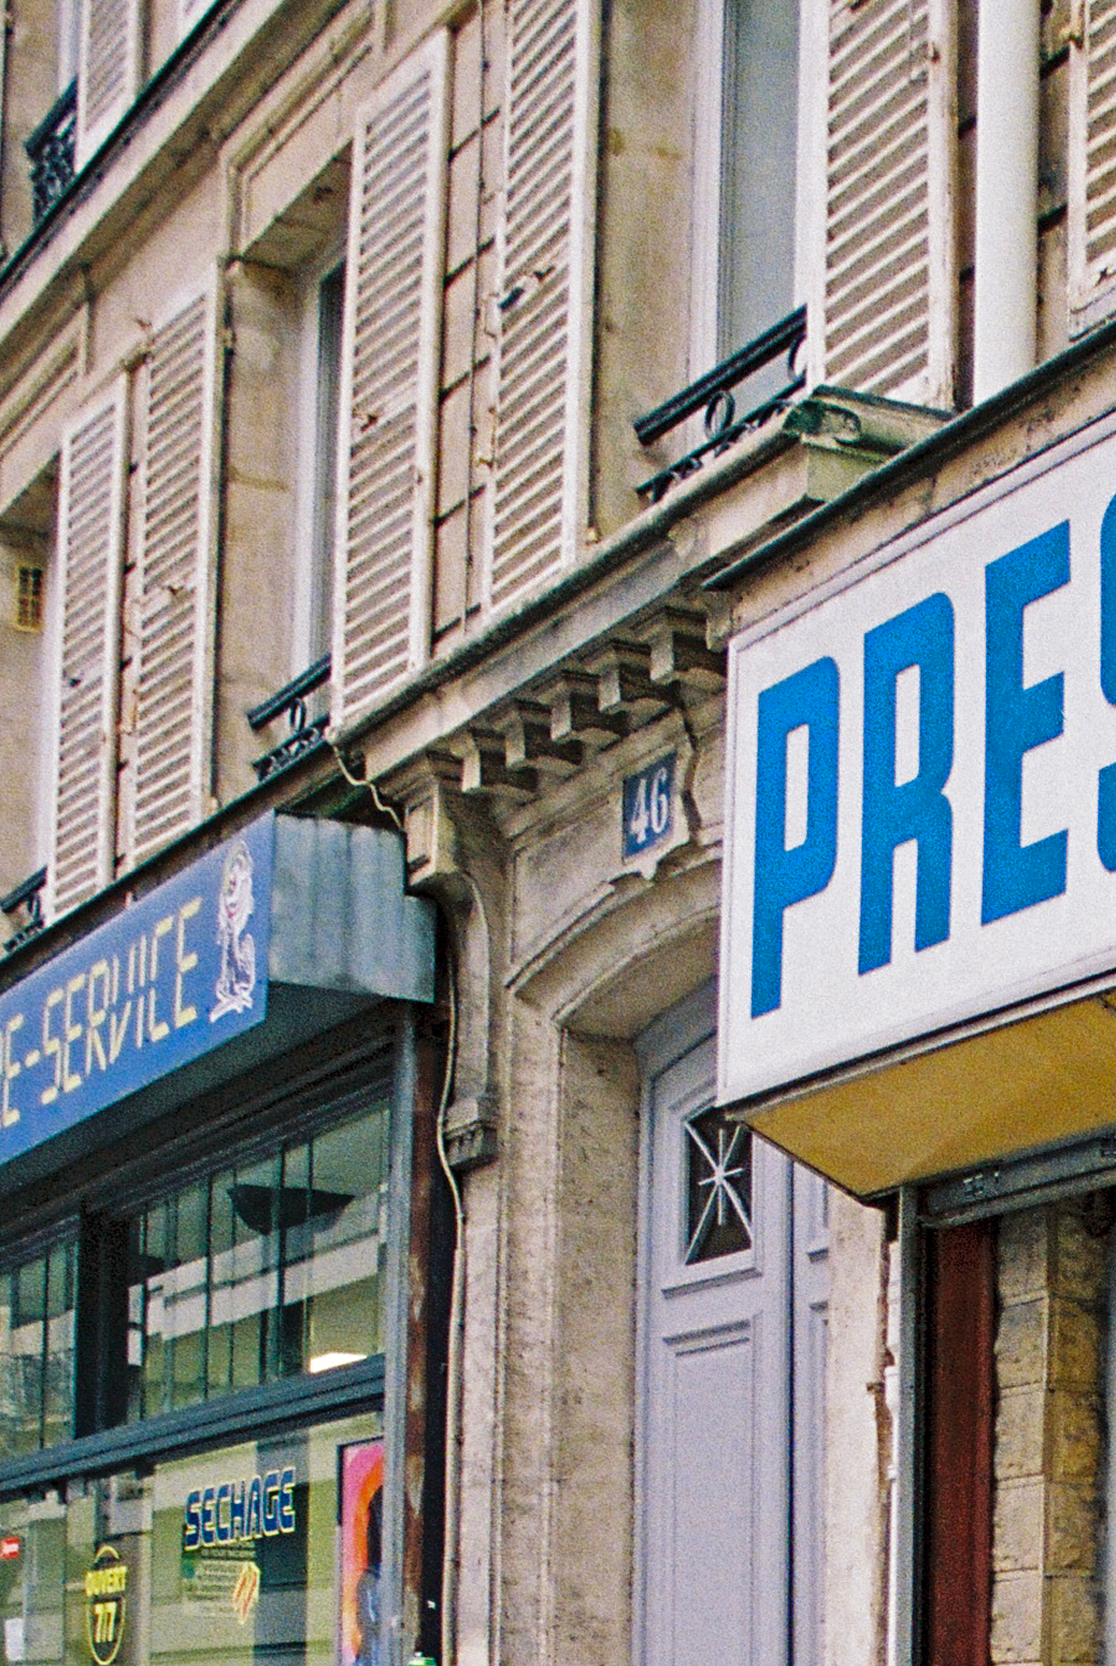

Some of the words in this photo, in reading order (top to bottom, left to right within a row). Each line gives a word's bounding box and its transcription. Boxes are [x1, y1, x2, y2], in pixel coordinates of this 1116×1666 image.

[629, 767, 668, 844] 46
[0, 897, 203, 1128] E-SERVICE
[183, 1466, 296, 1551] SECHAGE
[86, 1566, 127, 1597] OUVERT
